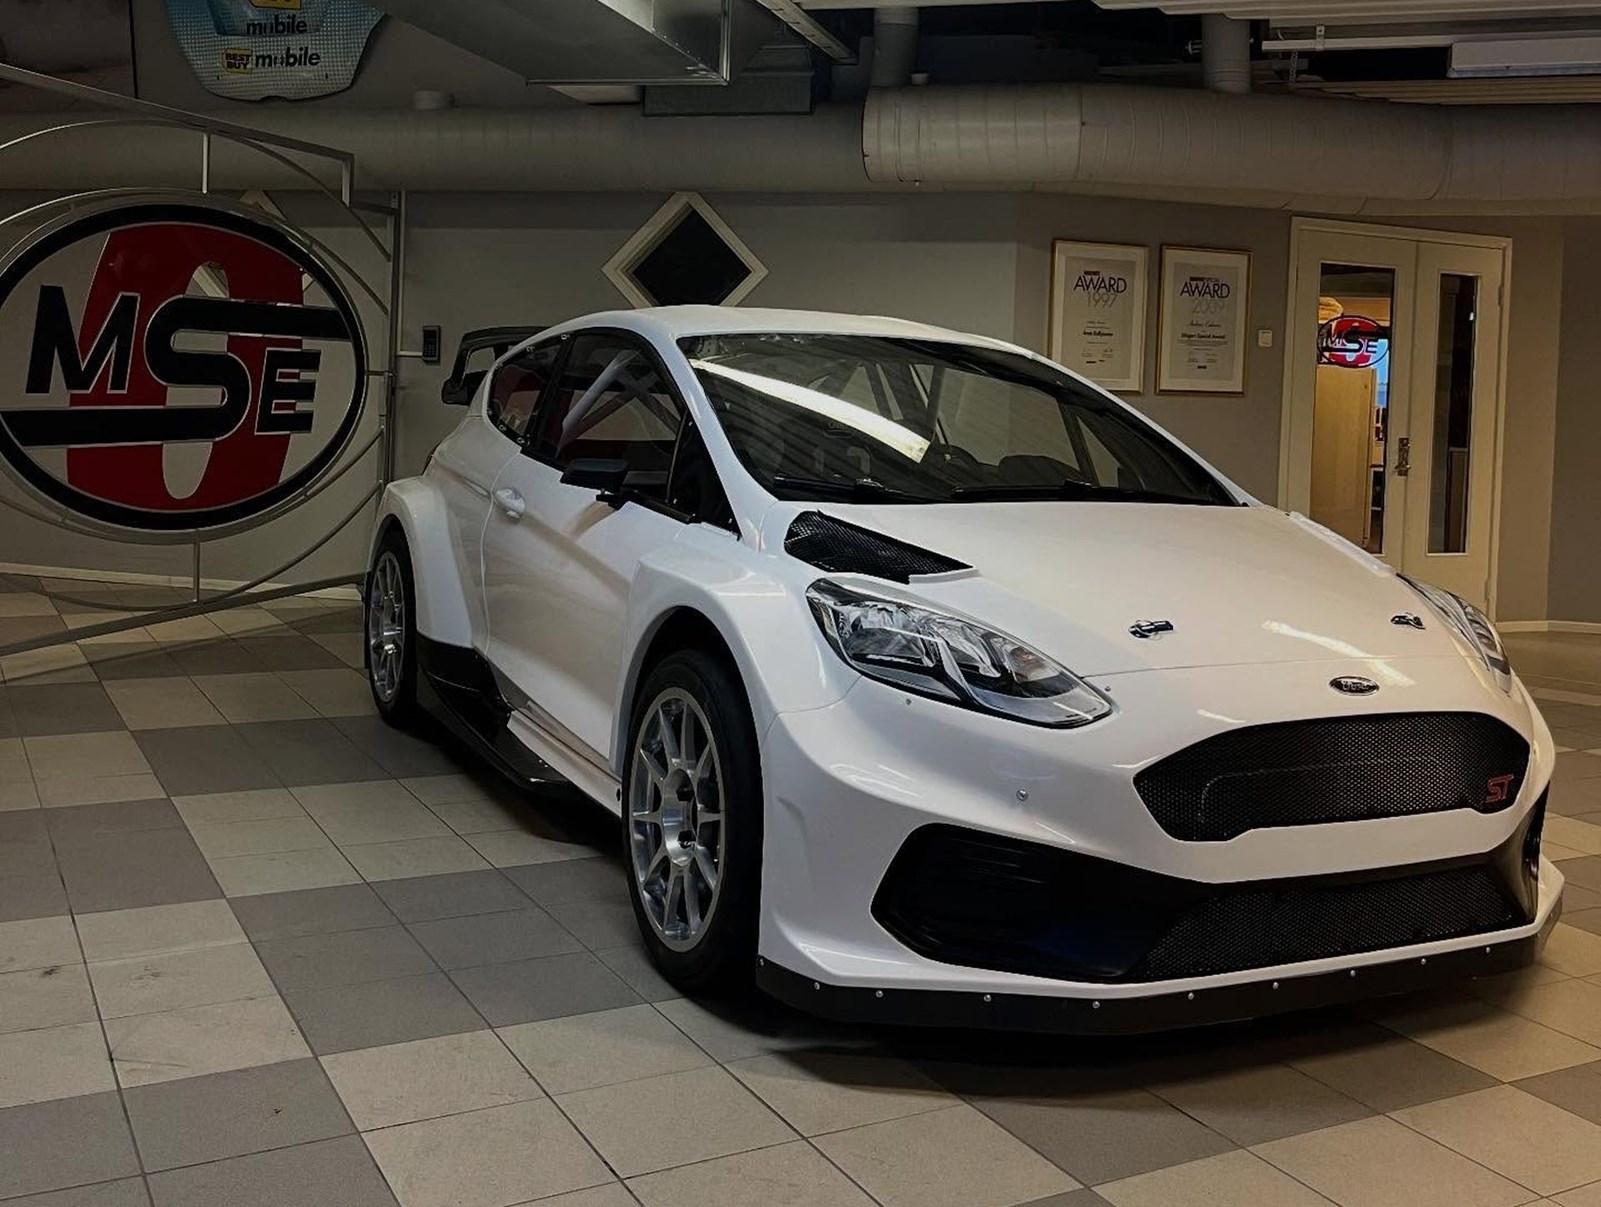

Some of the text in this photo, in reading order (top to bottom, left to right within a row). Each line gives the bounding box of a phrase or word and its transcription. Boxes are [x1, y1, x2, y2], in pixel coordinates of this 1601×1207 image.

[225, 52, 252, 62] BEST
[226, 60, 249, 70] BUY
[255, 46, 321, 68] mobile
[1073, 275, 1127, 293] AWARD
[1180, 281, 1231, 299] AWARD
[1087, 291, 1118, 308] 1997
[0, 284, 353, 449] MSE
[1485, 774, 1514, 803] ST
